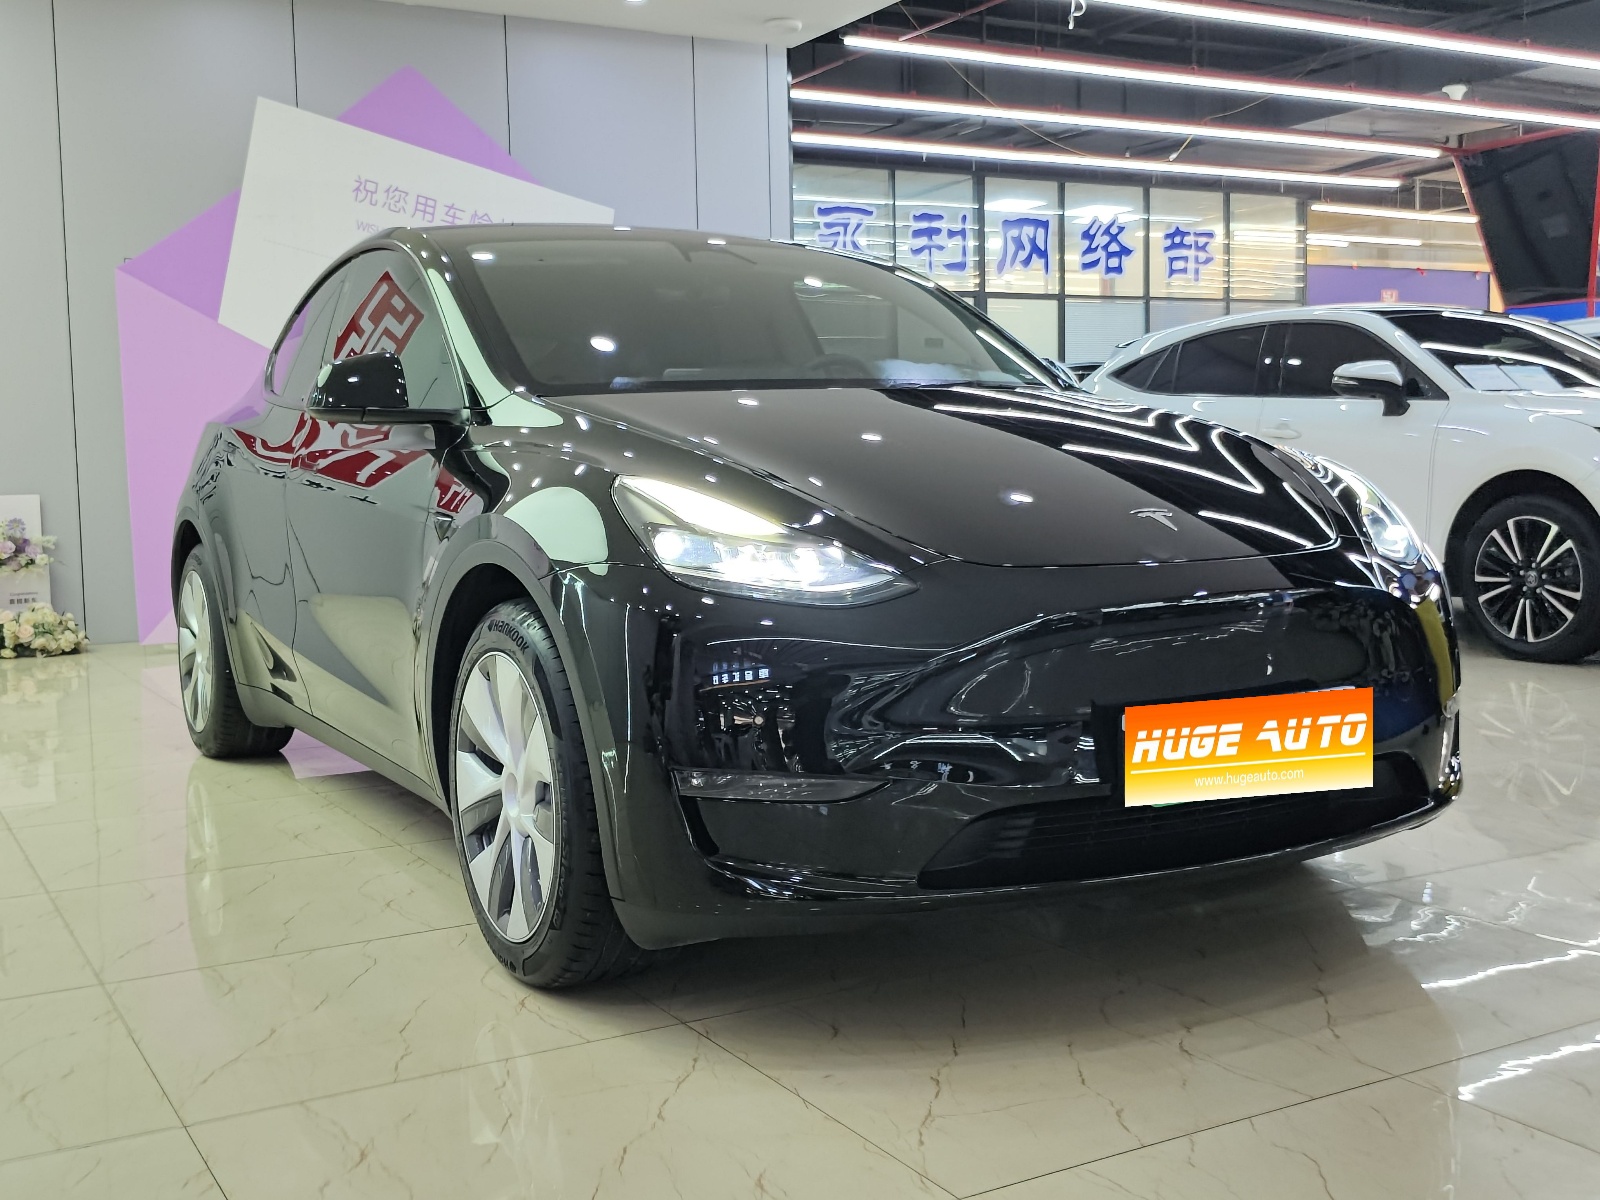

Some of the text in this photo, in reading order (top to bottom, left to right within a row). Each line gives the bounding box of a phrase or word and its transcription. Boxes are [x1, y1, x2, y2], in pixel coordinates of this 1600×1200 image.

[352, 175, 505, 225] 祝您用车
[817, 205, 1215, 281] 永利网络部
